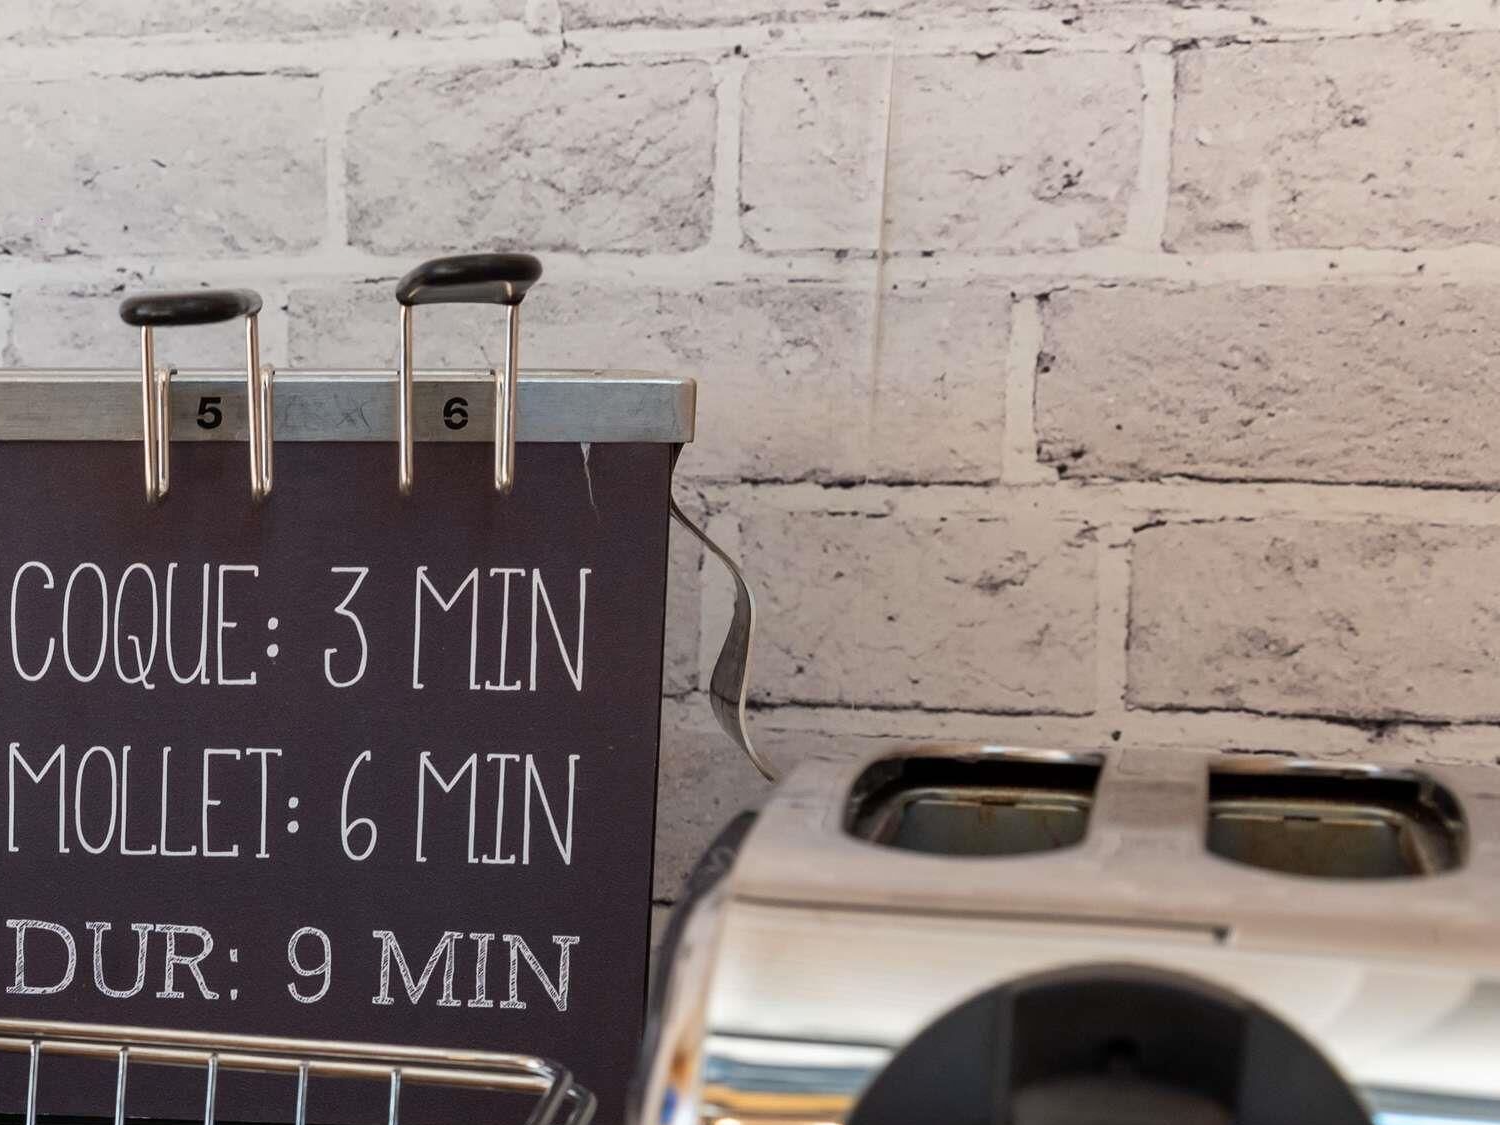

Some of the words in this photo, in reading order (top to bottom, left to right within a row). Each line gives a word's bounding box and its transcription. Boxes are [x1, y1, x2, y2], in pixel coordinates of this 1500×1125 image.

[197, 396, 222, 428] 5
[442, 396, 469, 430] 6
[11, 561, 278, 689] COQUE:
[325, 567, 368, 687] 3
[413, 566, 591, 691] MIN
[9, 743, 299, 858] MOLLET:
[341, 751, 377, 860] 6
[416, 752, 580, 865] MIN
[6, 919, 237, 1000] DUR:
[288, 927, 331, 1003] 9
[372, 930, 579, 1011] MIN
